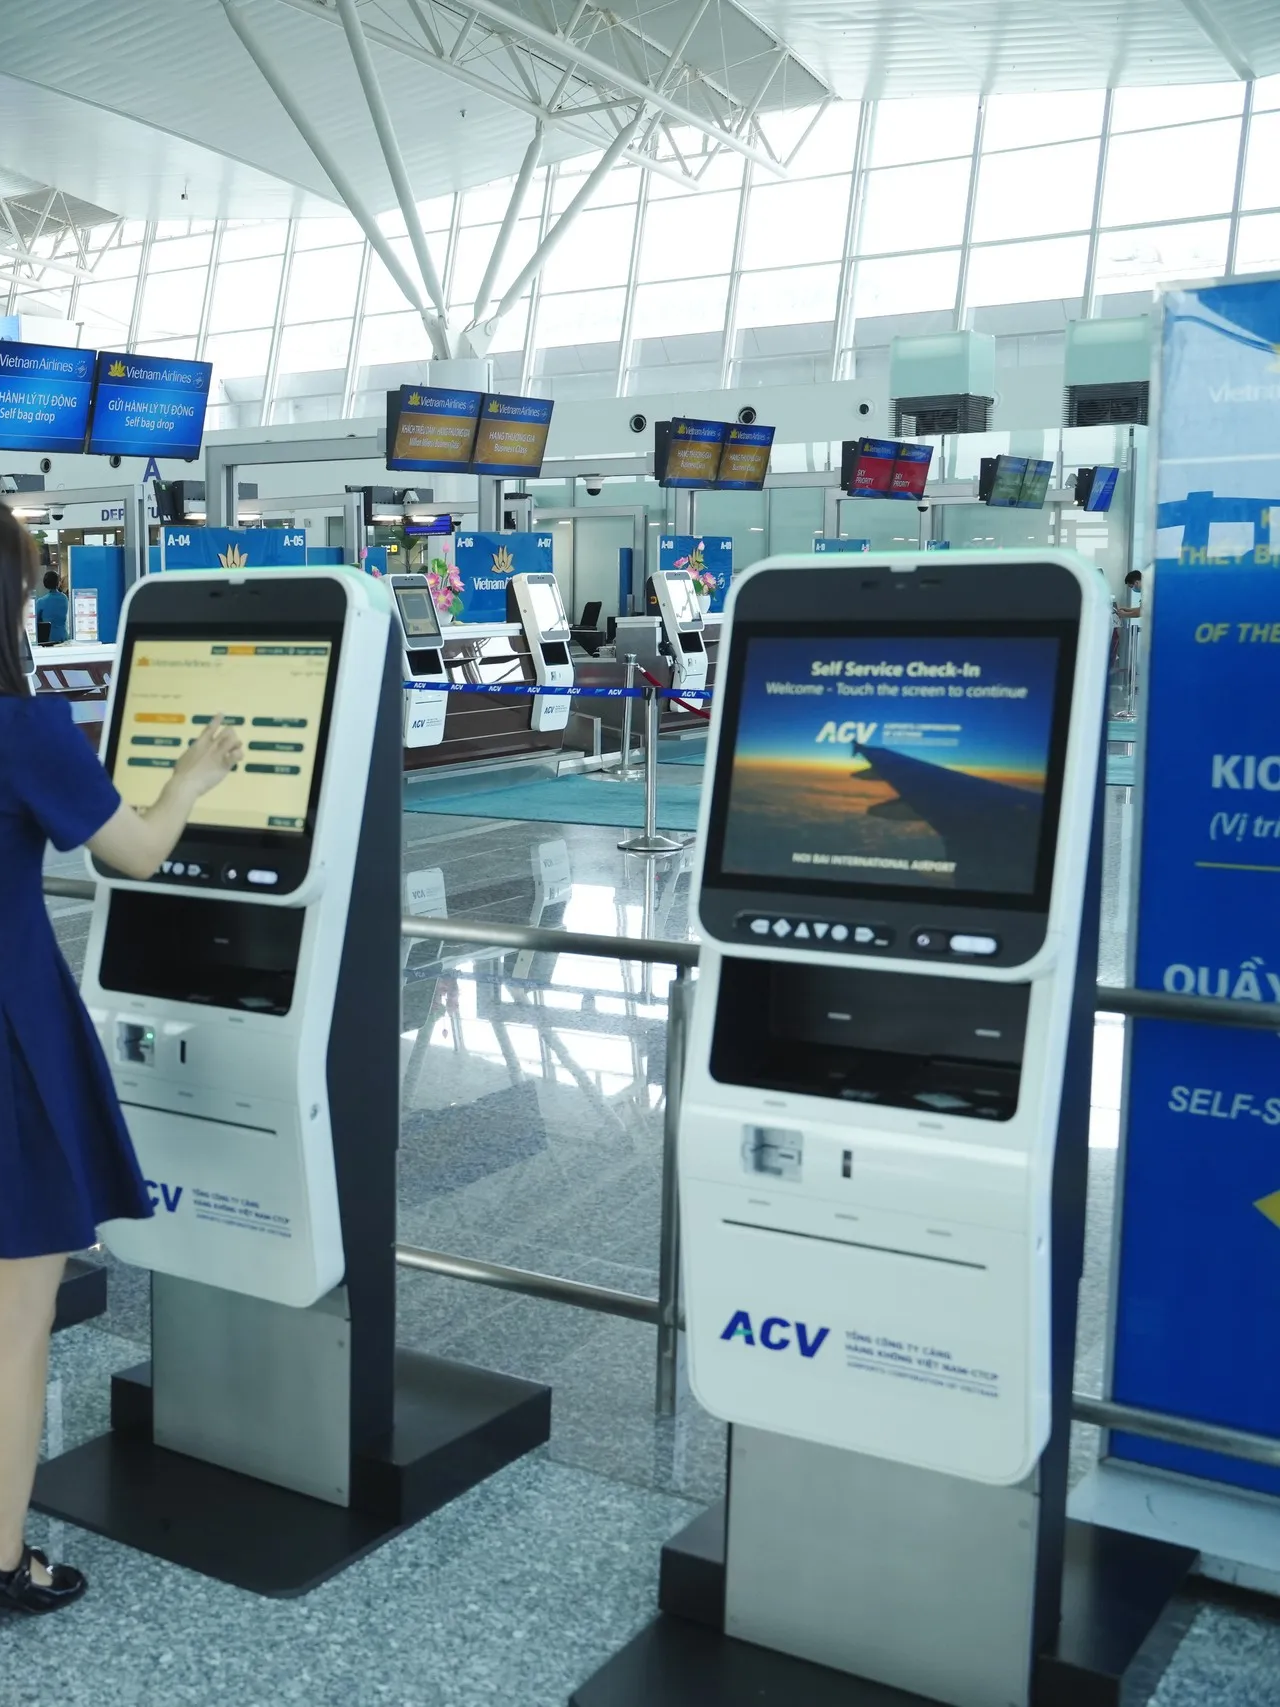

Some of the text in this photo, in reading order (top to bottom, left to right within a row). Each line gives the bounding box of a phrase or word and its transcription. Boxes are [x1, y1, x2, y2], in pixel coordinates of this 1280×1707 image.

[0, 353, 73, 373] Vietnam Airlines
[126, 366, 192, 384] Vietnam Airlines
[0, 390, 25, 404] HÀNH
[26, 391, 37, 405] LÝ
[38, 394, 51, 408] TỰ
[51, 393, 77, 410] ĐỘNG
[108, 397, 123, 411] GỬI
[125, 400, 148, 413] HÀNH
[149, 402, 159, 414] LÝ
[160, 404, 171, 417] TỰ
[0, 407, 55, 424] Self bag drop
[125, 416, 175, 432] Self bag drop
[167, 534, 191, 547] A-04
[283, 535, 304, 547] A-05
[473, 577, 502, 590] Vietnam
[1195, 623, 1230, 643] OF
[811, 660, 980, 678] Self Service Check-In
[766, 681, 824, 695] Welcome
[836, 682, 874, 697] Touch
[877, 683, 898, 697] the
[902, 685, 945, 697] screen
[948, 684, 963, 697] to
[966, 684, 1028, 698] continue
[412, 720, 426, 729] ACV
[815, 721, 877, 744] ACV
[1211, 754, 1280, 791] KIO
[831, 855, 909, 870] INTERNATIONAL
[911, 859, 956, 873] AIRPORT
[1168, 1085, 1280, 1125] SELF-S
[143, 1179, 183, 1213] CV
[720, 1310, 830, 1359] ACV
